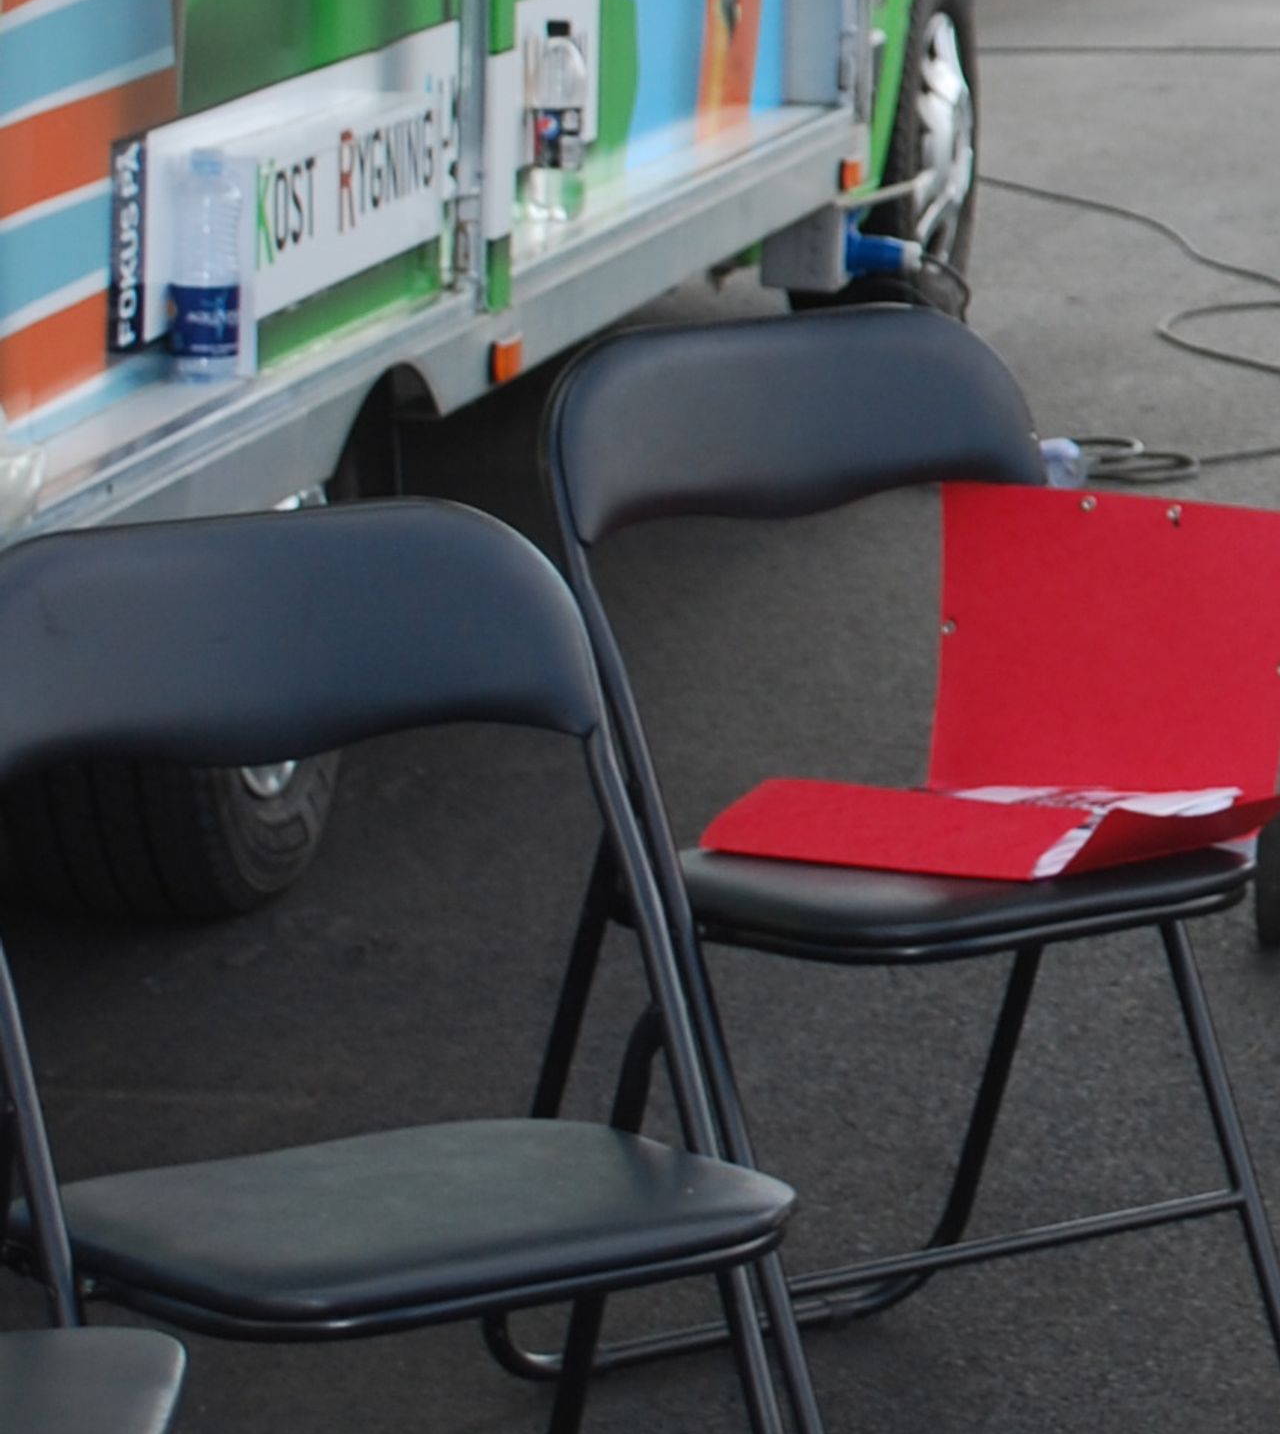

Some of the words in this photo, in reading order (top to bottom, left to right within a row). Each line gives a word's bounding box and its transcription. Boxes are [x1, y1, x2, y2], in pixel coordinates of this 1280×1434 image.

[255, 154, 317, 272] KOST
[338, 109, 435, 235] RYGNING
[116, 200, 141, 348] FOKUS
